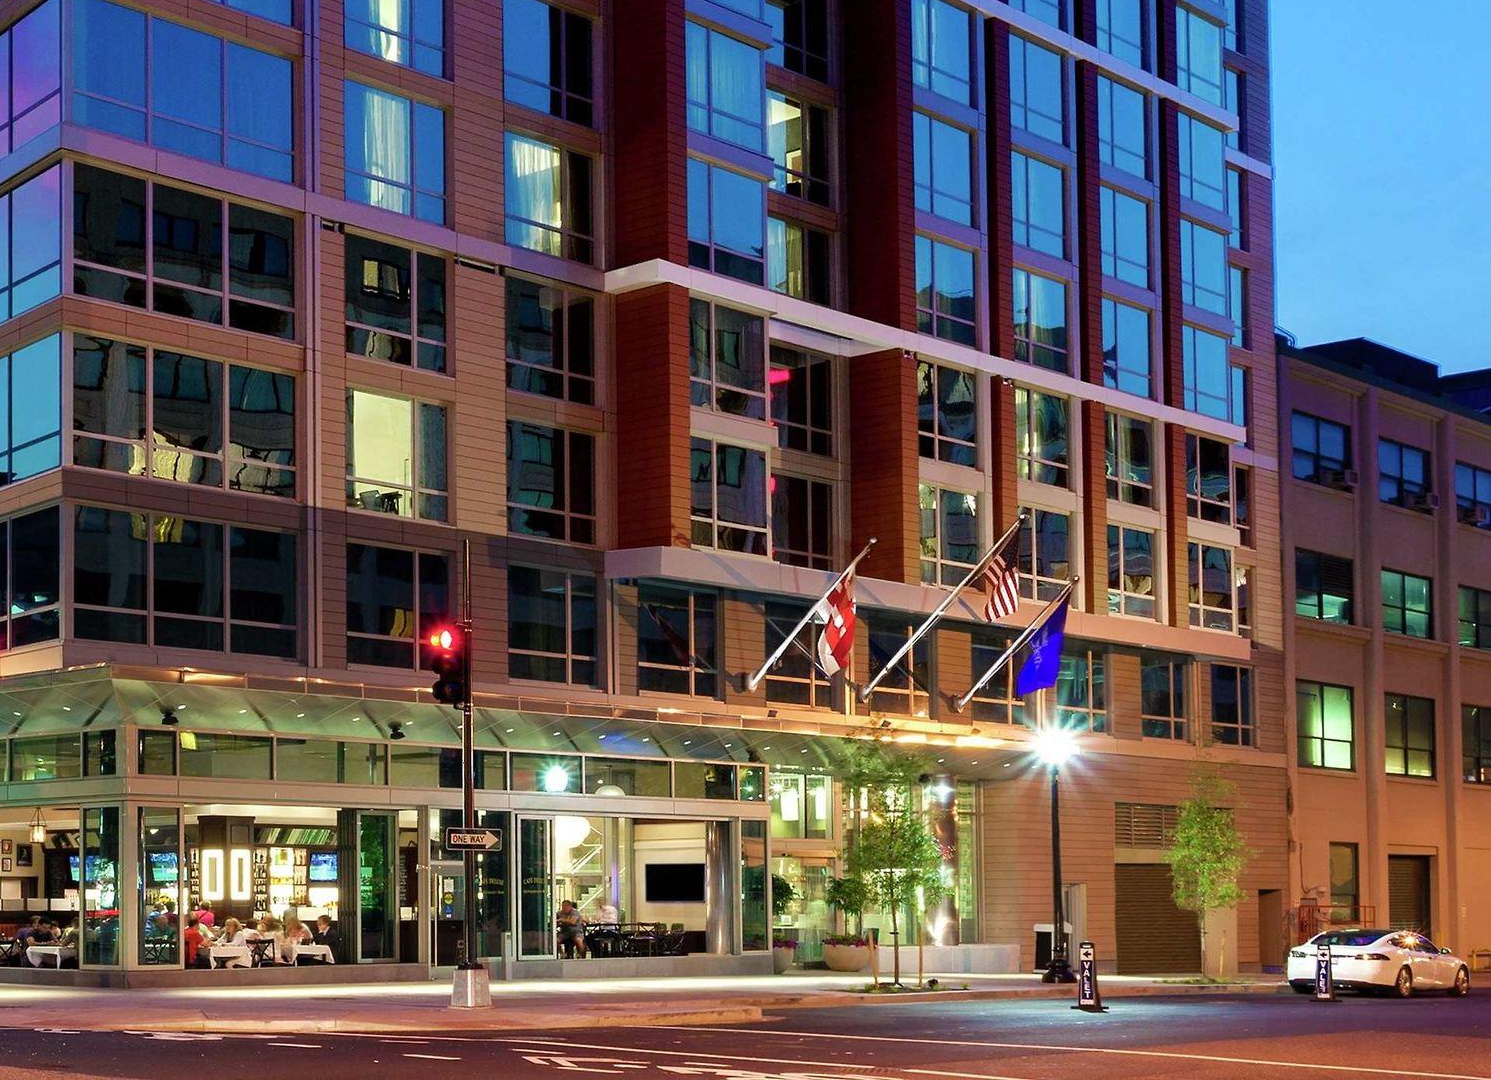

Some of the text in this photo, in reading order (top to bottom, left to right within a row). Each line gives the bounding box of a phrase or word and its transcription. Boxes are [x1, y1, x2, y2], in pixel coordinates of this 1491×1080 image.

[452, 834, 485, 843] ONE WAY
[1083, 962, 1091, 998] VALET
